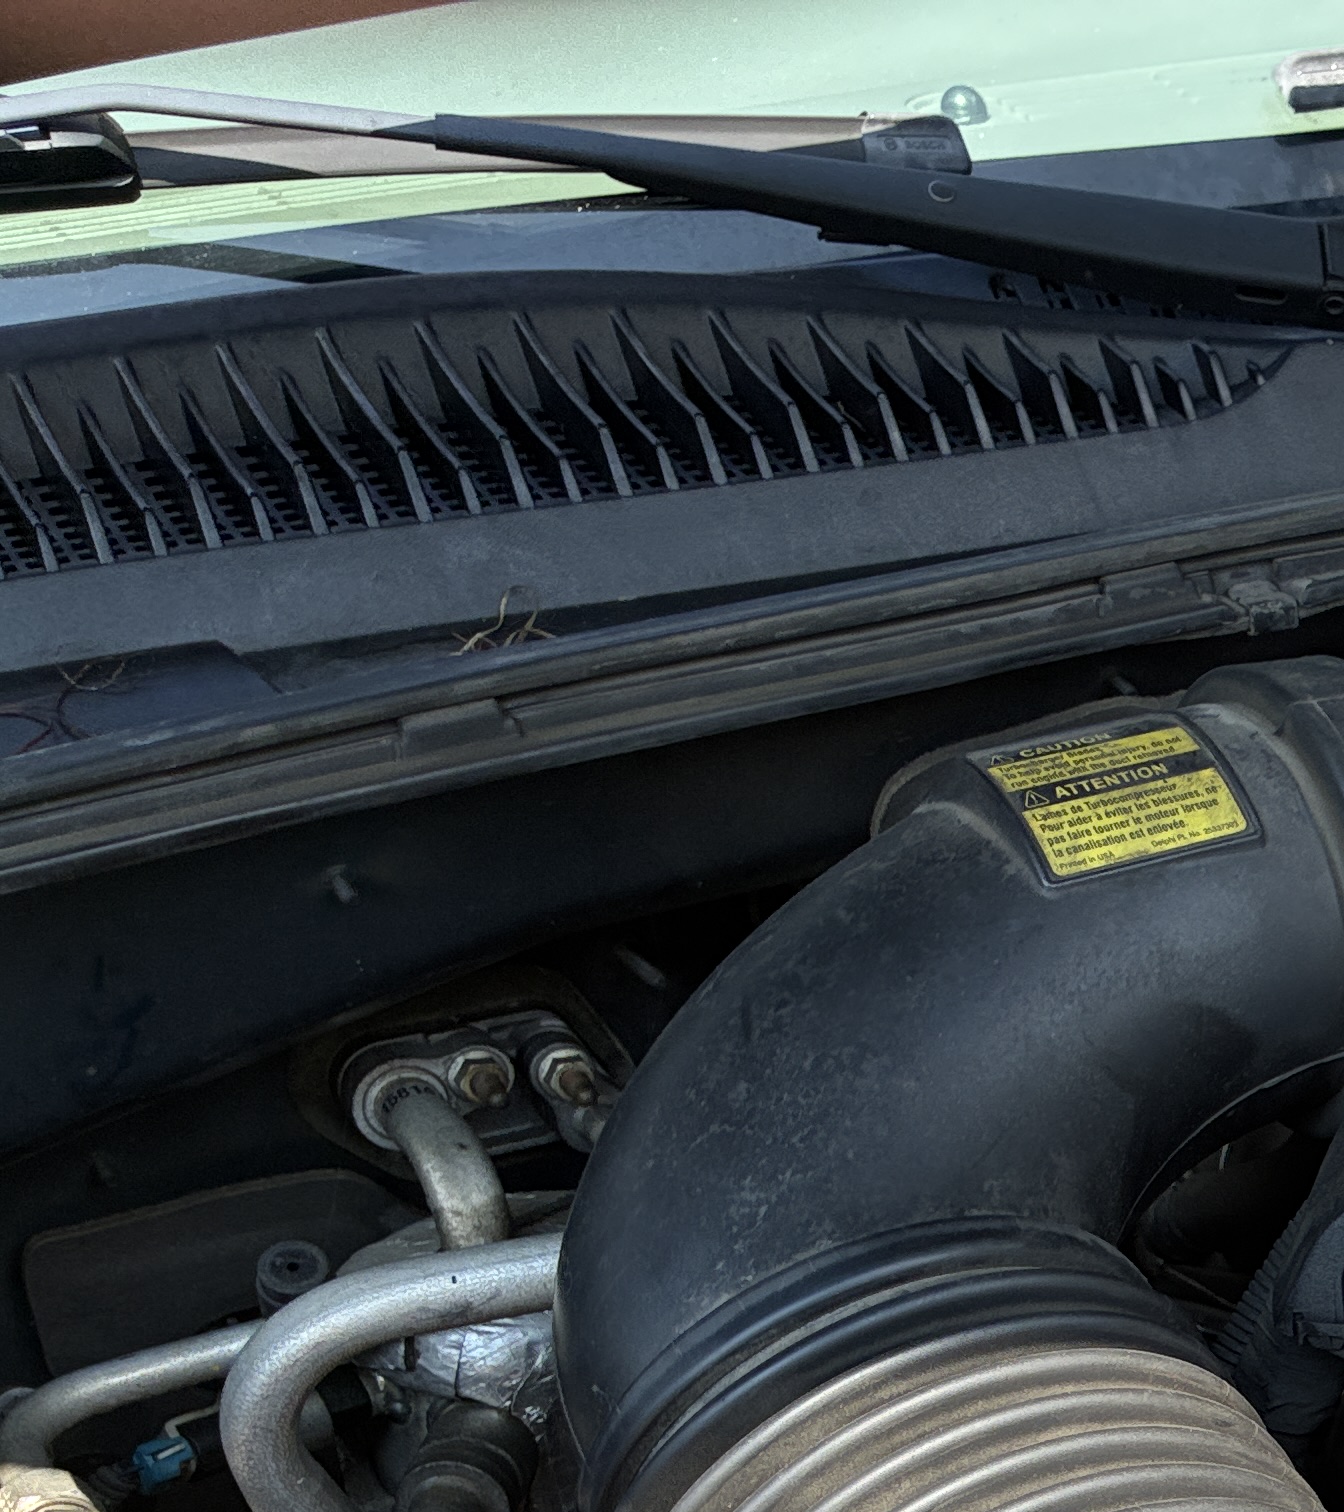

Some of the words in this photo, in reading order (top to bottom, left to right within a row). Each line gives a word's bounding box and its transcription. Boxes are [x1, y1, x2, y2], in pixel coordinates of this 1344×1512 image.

[1020, 732, 1112, 758] CAUTION
[1055, 762, 1170, 799] ATTENTION
[1039, 821, 1066, 834] Pour
[1067, 814, 1093, 828] aider
[1096, 810, 1104, 822] à
[1104, 806, 1134, 821] éviter
[1135, 801, 1152, 813] les
[1045, 834, 1066, 849] pas
[1066, 828, 1093, 842] faire
[1095, 819, 1132, 836] tourner
[1132, 814, 1144, 826] le
[1144, 807, 1181, 825] moteur
[1180, 797, 1221, 815] lorsque
[1070, 803, 1084, 815] de
[1051, 846, 1065, 859] la
[1065, 832, 1128, 857] canalisation
[1129, 829, 1146, 841] est
